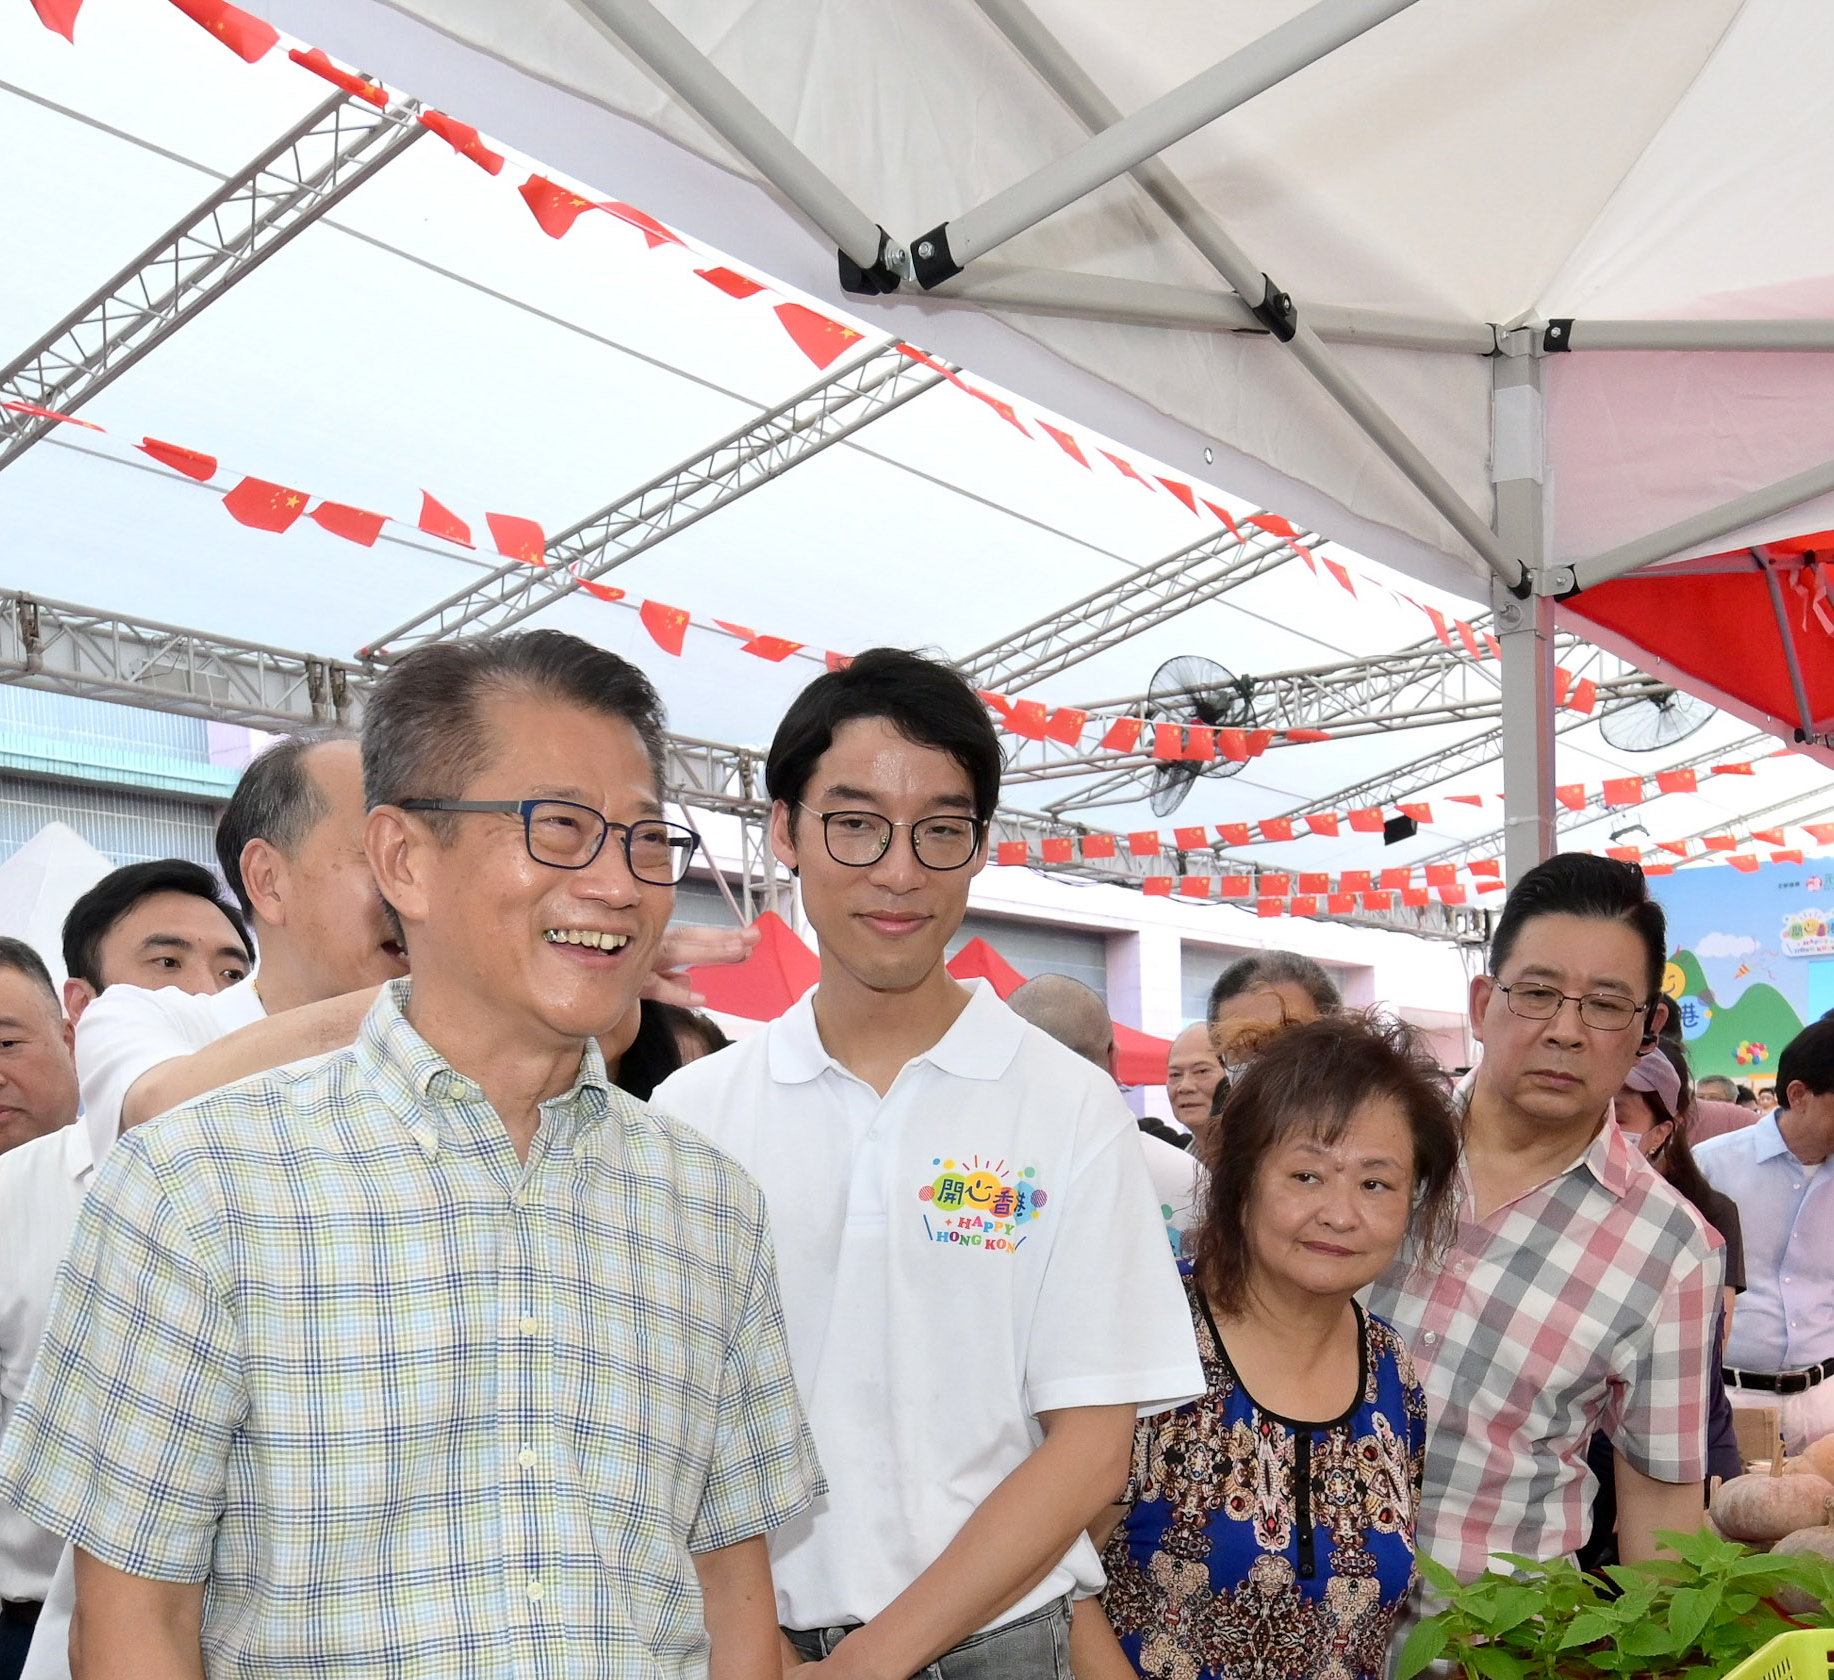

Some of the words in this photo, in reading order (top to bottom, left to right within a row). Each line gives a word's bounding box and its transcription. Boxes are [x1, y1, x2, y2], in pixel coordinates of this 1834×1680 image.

[957, 1215, 1016, 1237] HAPPY
[935, 1230, 983, 1247] HONG
[984, 1238, 1017, 1254] KON
